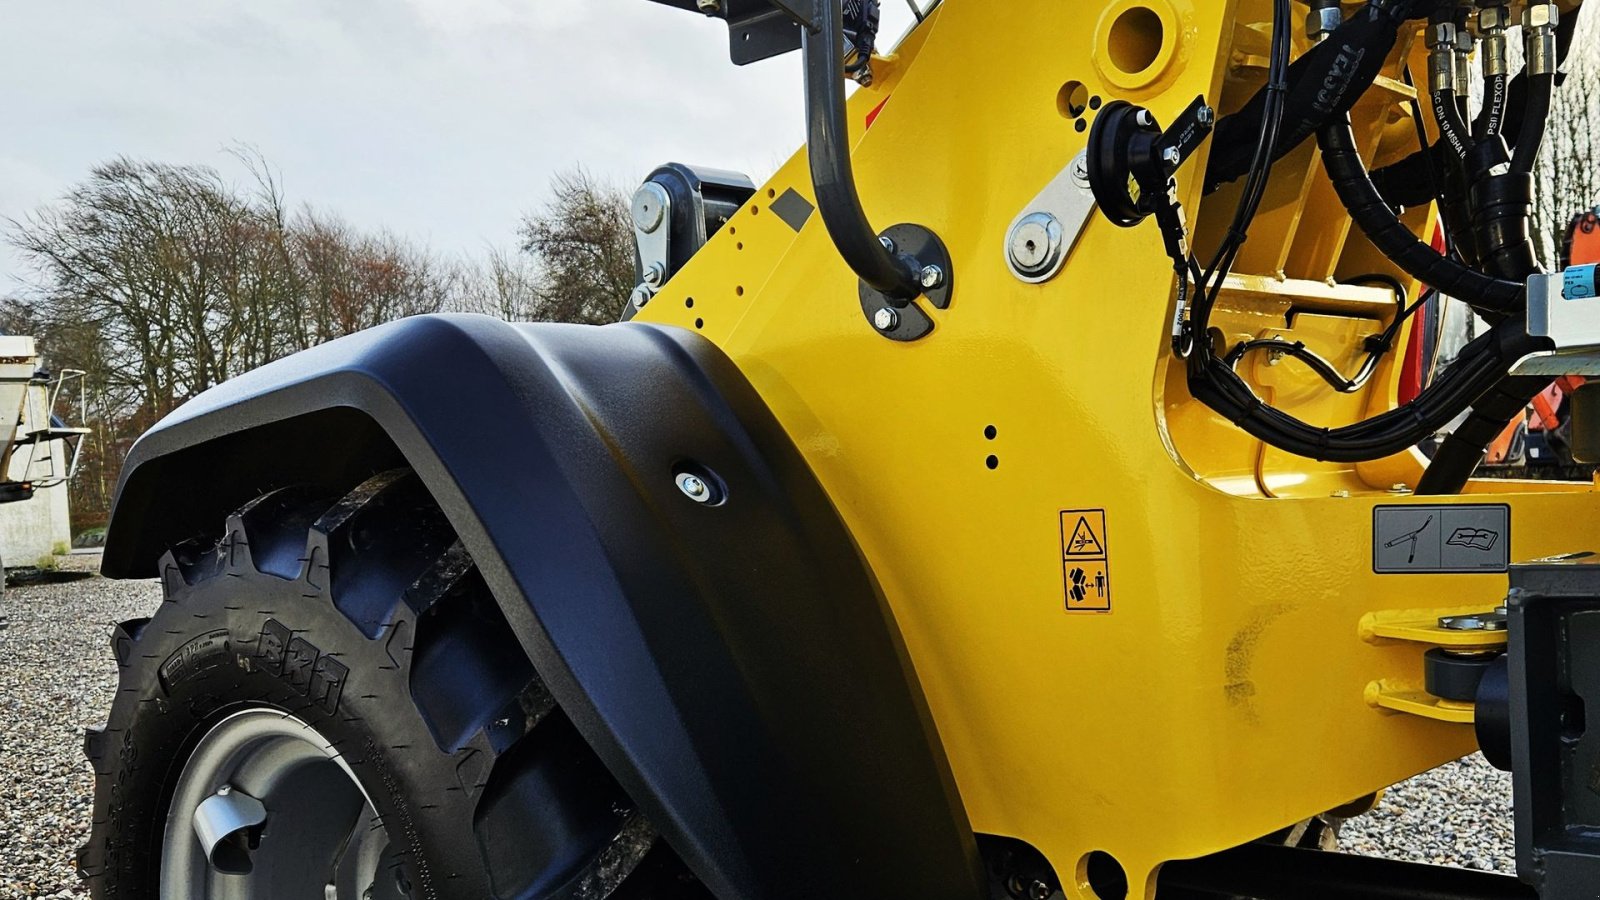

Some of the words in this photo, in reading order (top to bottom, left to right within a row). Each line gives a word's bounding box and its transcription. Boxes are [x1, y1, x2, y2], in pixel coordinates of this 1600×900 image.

[1492, 75, 1503, 115] FLEXOP
[1436, 105, 1446, 120] DN
[1442, 120, 1451, 131] 10
[1446, 129, 1464, 154] MSHA
[257, 622, 346, 712] BKT
